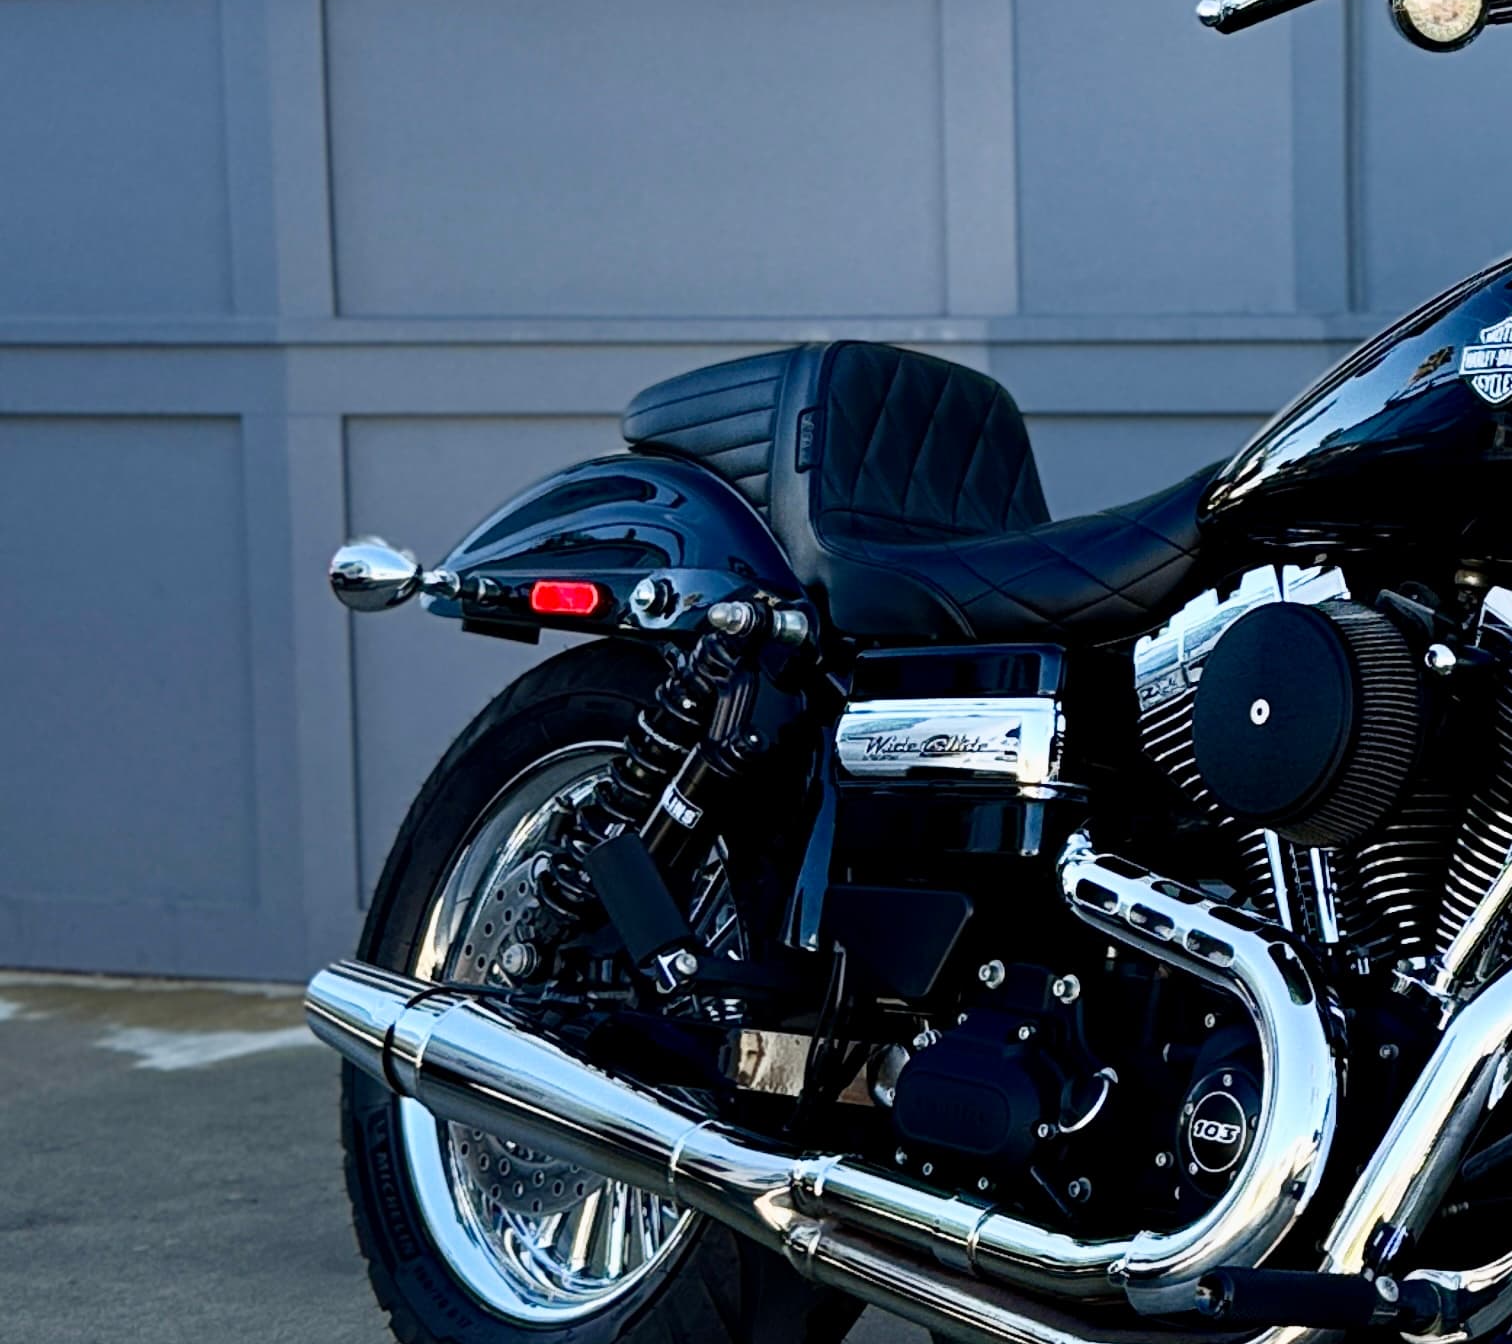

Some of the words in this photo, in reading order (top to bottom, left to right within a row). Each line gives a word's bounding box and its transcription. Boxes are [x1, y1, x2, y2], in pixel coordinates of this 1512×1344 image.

[850, 735, 918, 755] Wide
[919, 734, 991, 757] Glide
[661, 785, 697, 825] LINS
[1193, 1119, 1241, 1144] 103
